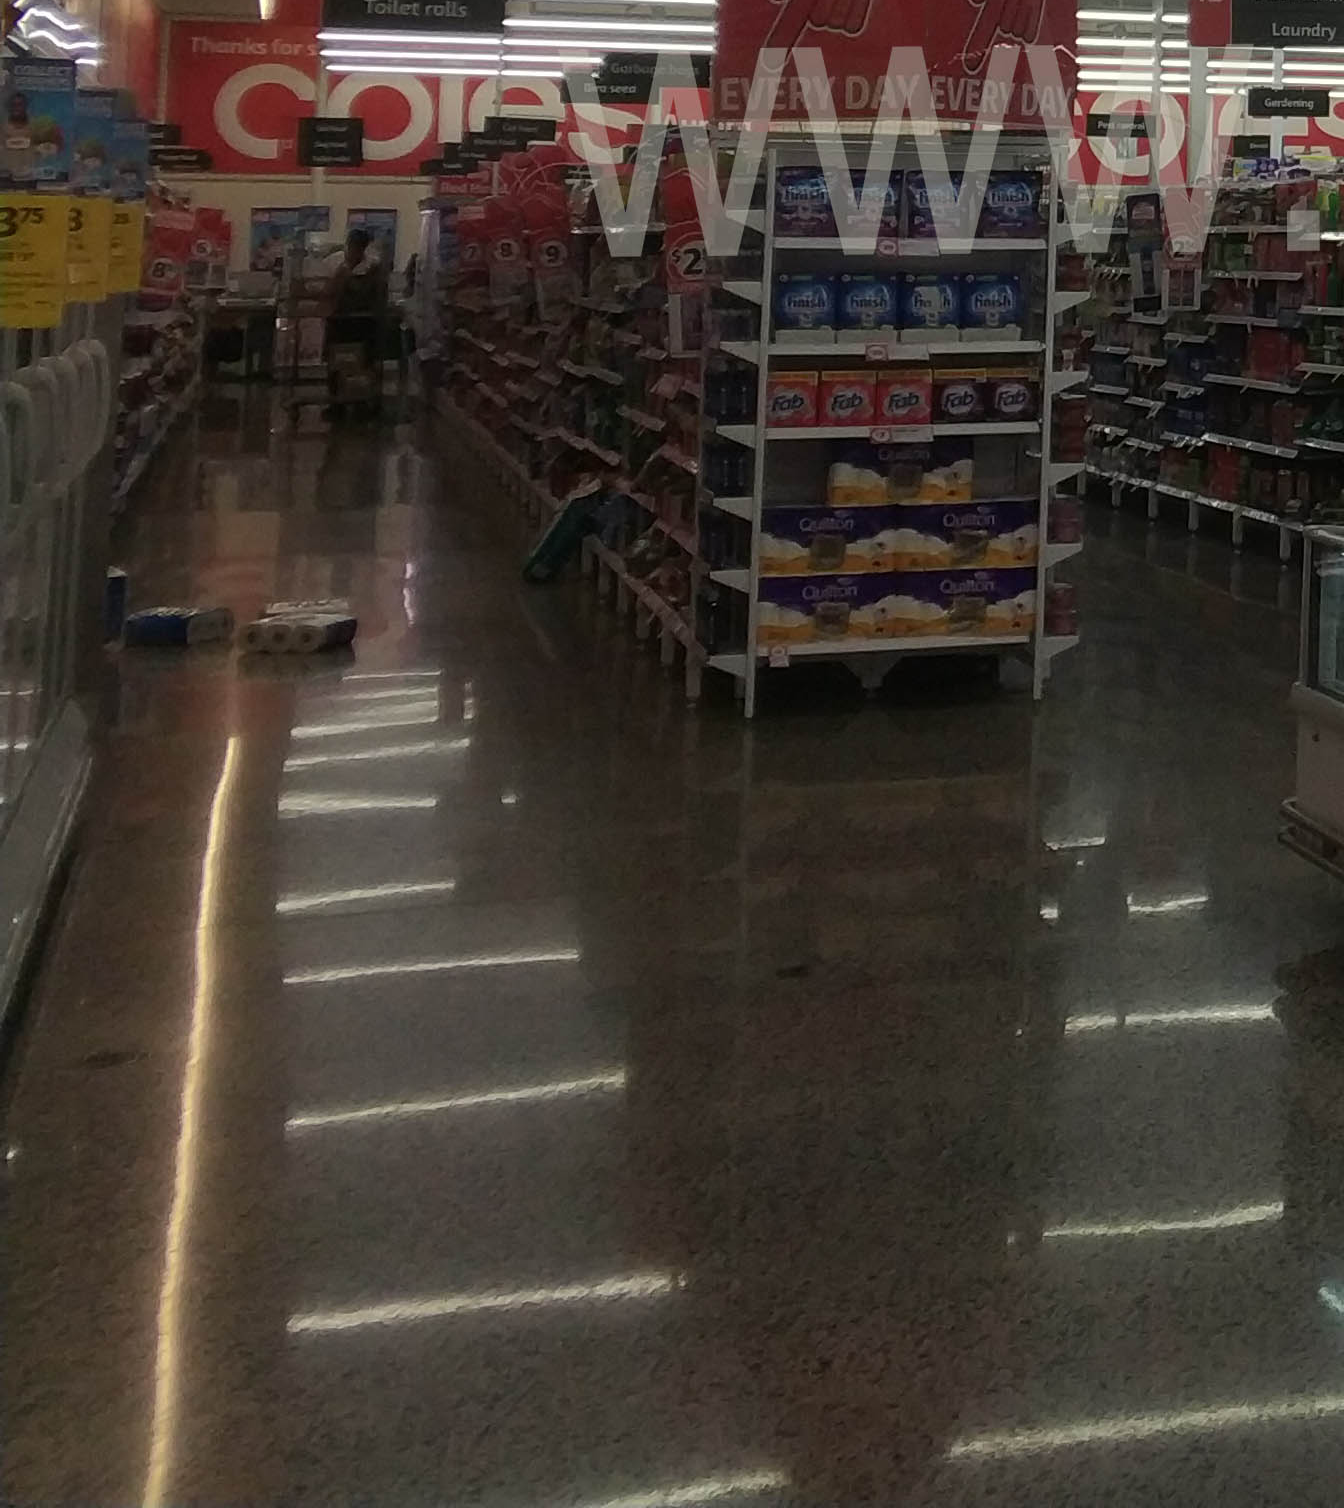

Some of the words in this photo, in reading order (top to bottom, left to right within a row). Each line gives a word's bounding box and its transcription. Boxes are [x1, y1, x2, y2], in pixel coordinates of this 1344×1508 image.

[425, 0, 468, 18] rolls
[1271, 21, 1337, 43] Laundry
[191, 36, 267, 55] Thanks
[271, 37, 304, 55] for
[719, 75, 834, 111] EVERY
[845, 73, 919, 110] DAY
[931, 77, 1017, 114] EVERY
[1021, 81, 1075, 118] DAY
[1264, 98, 1315, 111] Gardening
[787, 292, 826, 309] finish
[850, 292, 888, 309] finish
[914, 291, 951, 308] finh
[974, 291, 1012, 308] finish
[771, 394, 805, 413] Fab
[832, 391, 864, 412] Fab
[887, 392, 920, 412] Fab
[944, 390, 975, 409] Fab
[997, 389, 1027, 408] Fab
